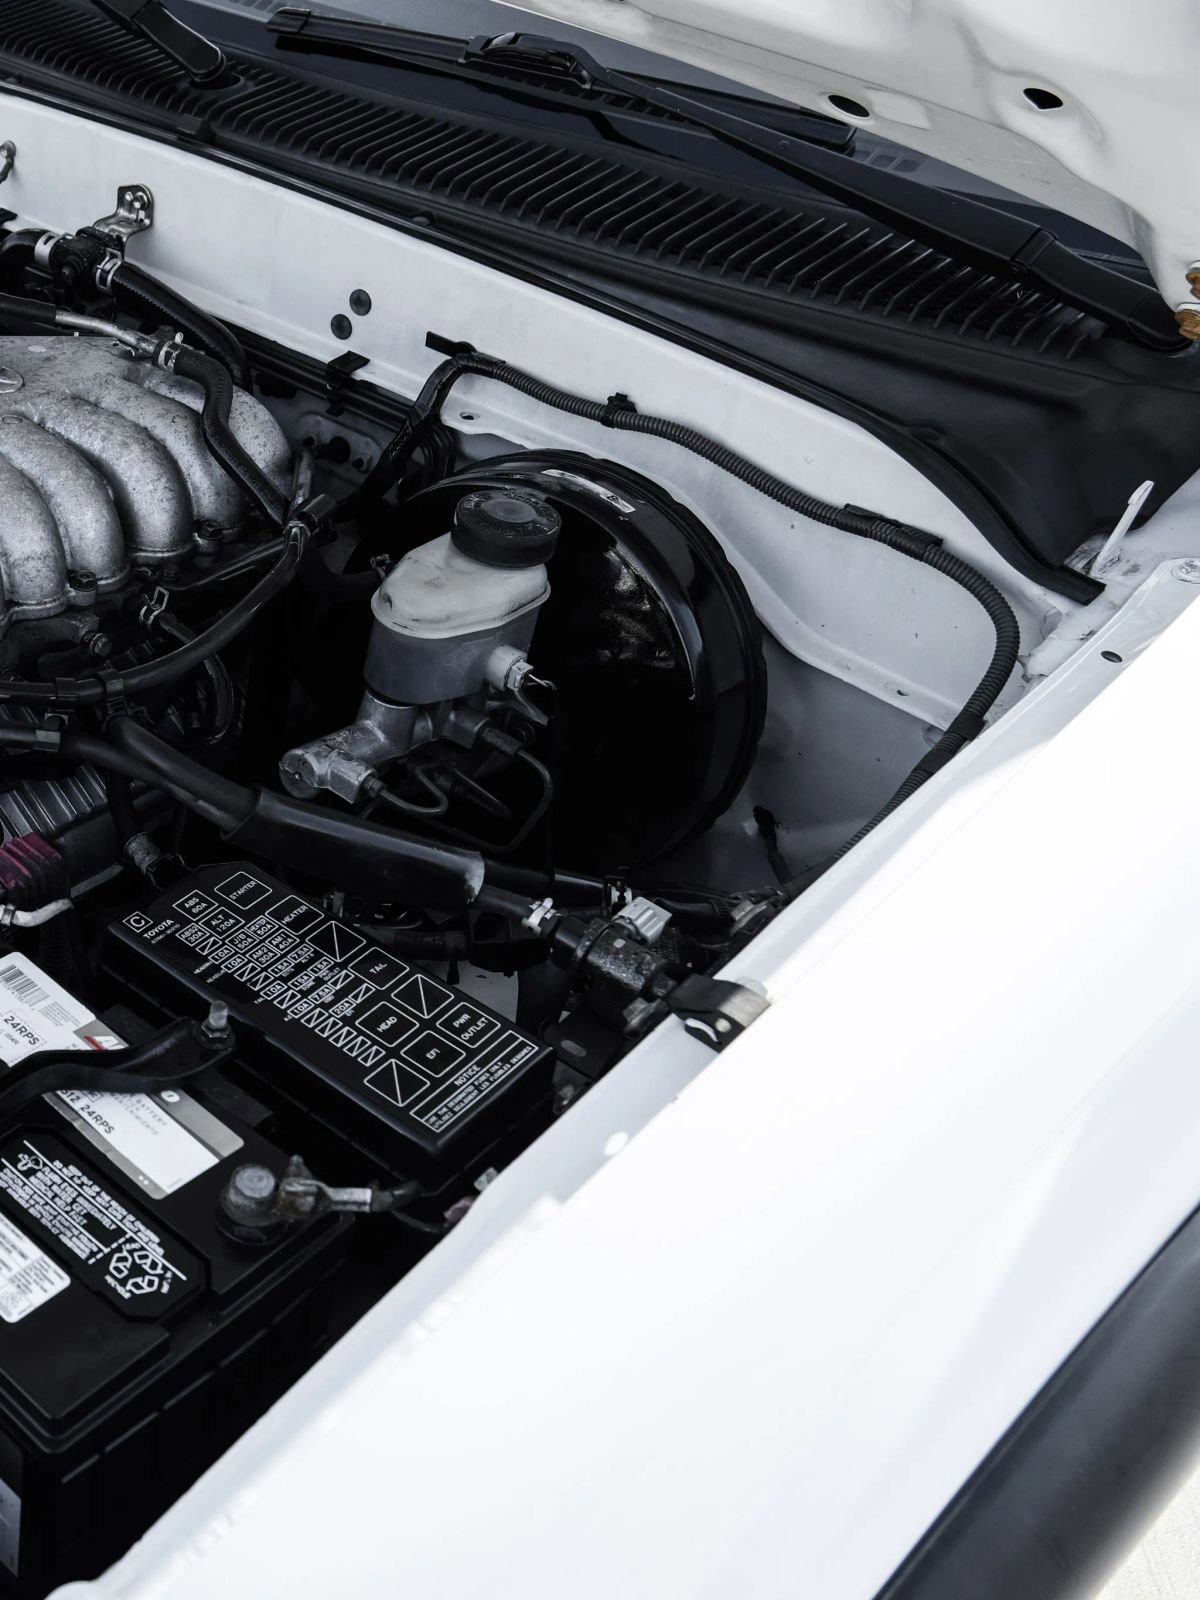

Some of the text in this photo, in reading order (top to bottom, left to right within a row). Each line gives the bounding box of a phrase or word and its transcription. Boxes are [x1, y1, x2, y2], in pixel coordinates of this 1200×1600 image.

[229, 881, 257, 900] STARTER
[184, 897, 200, 909] ABS
[191, 902, 208, 914] 60A
[211, 914, 225, 926] ALT
[280, 905, 308, 925] HEATER
[129, 916, 145, 927] C
[216, 919, 236, 932] 120A
[143, 919, 175, 939] TOYOTA
[180, 926, 198, 940] ABS2
[256, 923, 274, 937] 50A
[188, 931, 204, 942] 30A
[233, 935, 246, 945] J/B
[271, 934, 286, 946] AM1
[237, 938, 254, 949] 50A
[277, 937, 294, 950] 40A
[215, 949, 231, 961] 10A
[252, 947, 268, 959] AM2
[259, 952, 275, 964] 30A
[228, 958, 243, 970] 10A
[274, 947, 310, 973] 15A 7.5A
[294, 961, 330, 985] 15A 15A
[323, 967, 340, 980] OUTLET
[369, 963, 387, 975] TAIL
[266, 985, 282, 996] 10A
[312, 988, 330, 1000] 7.5A
[293, 1003, 309, 1014] 10A
[334, 1003, 351, 1014] 20A
[377, 1016, 398, 1033] HEAD
[453, 1013, 471, 1028] PWR
[4, 1015, 41, 1046] 24RPS
[462, 1017, 489, 1040] OUTLET
[426, 1048, 440, 1060] EFI
[454, 1065, 481, 1086] NOTICE
[137, 1099, 168, 1126] BATTERY
[80, 1104, 115, 1134] 24RPS
[59, 1182, 78, 1197] EYES
[71, 1203, 87, 1214] GET
